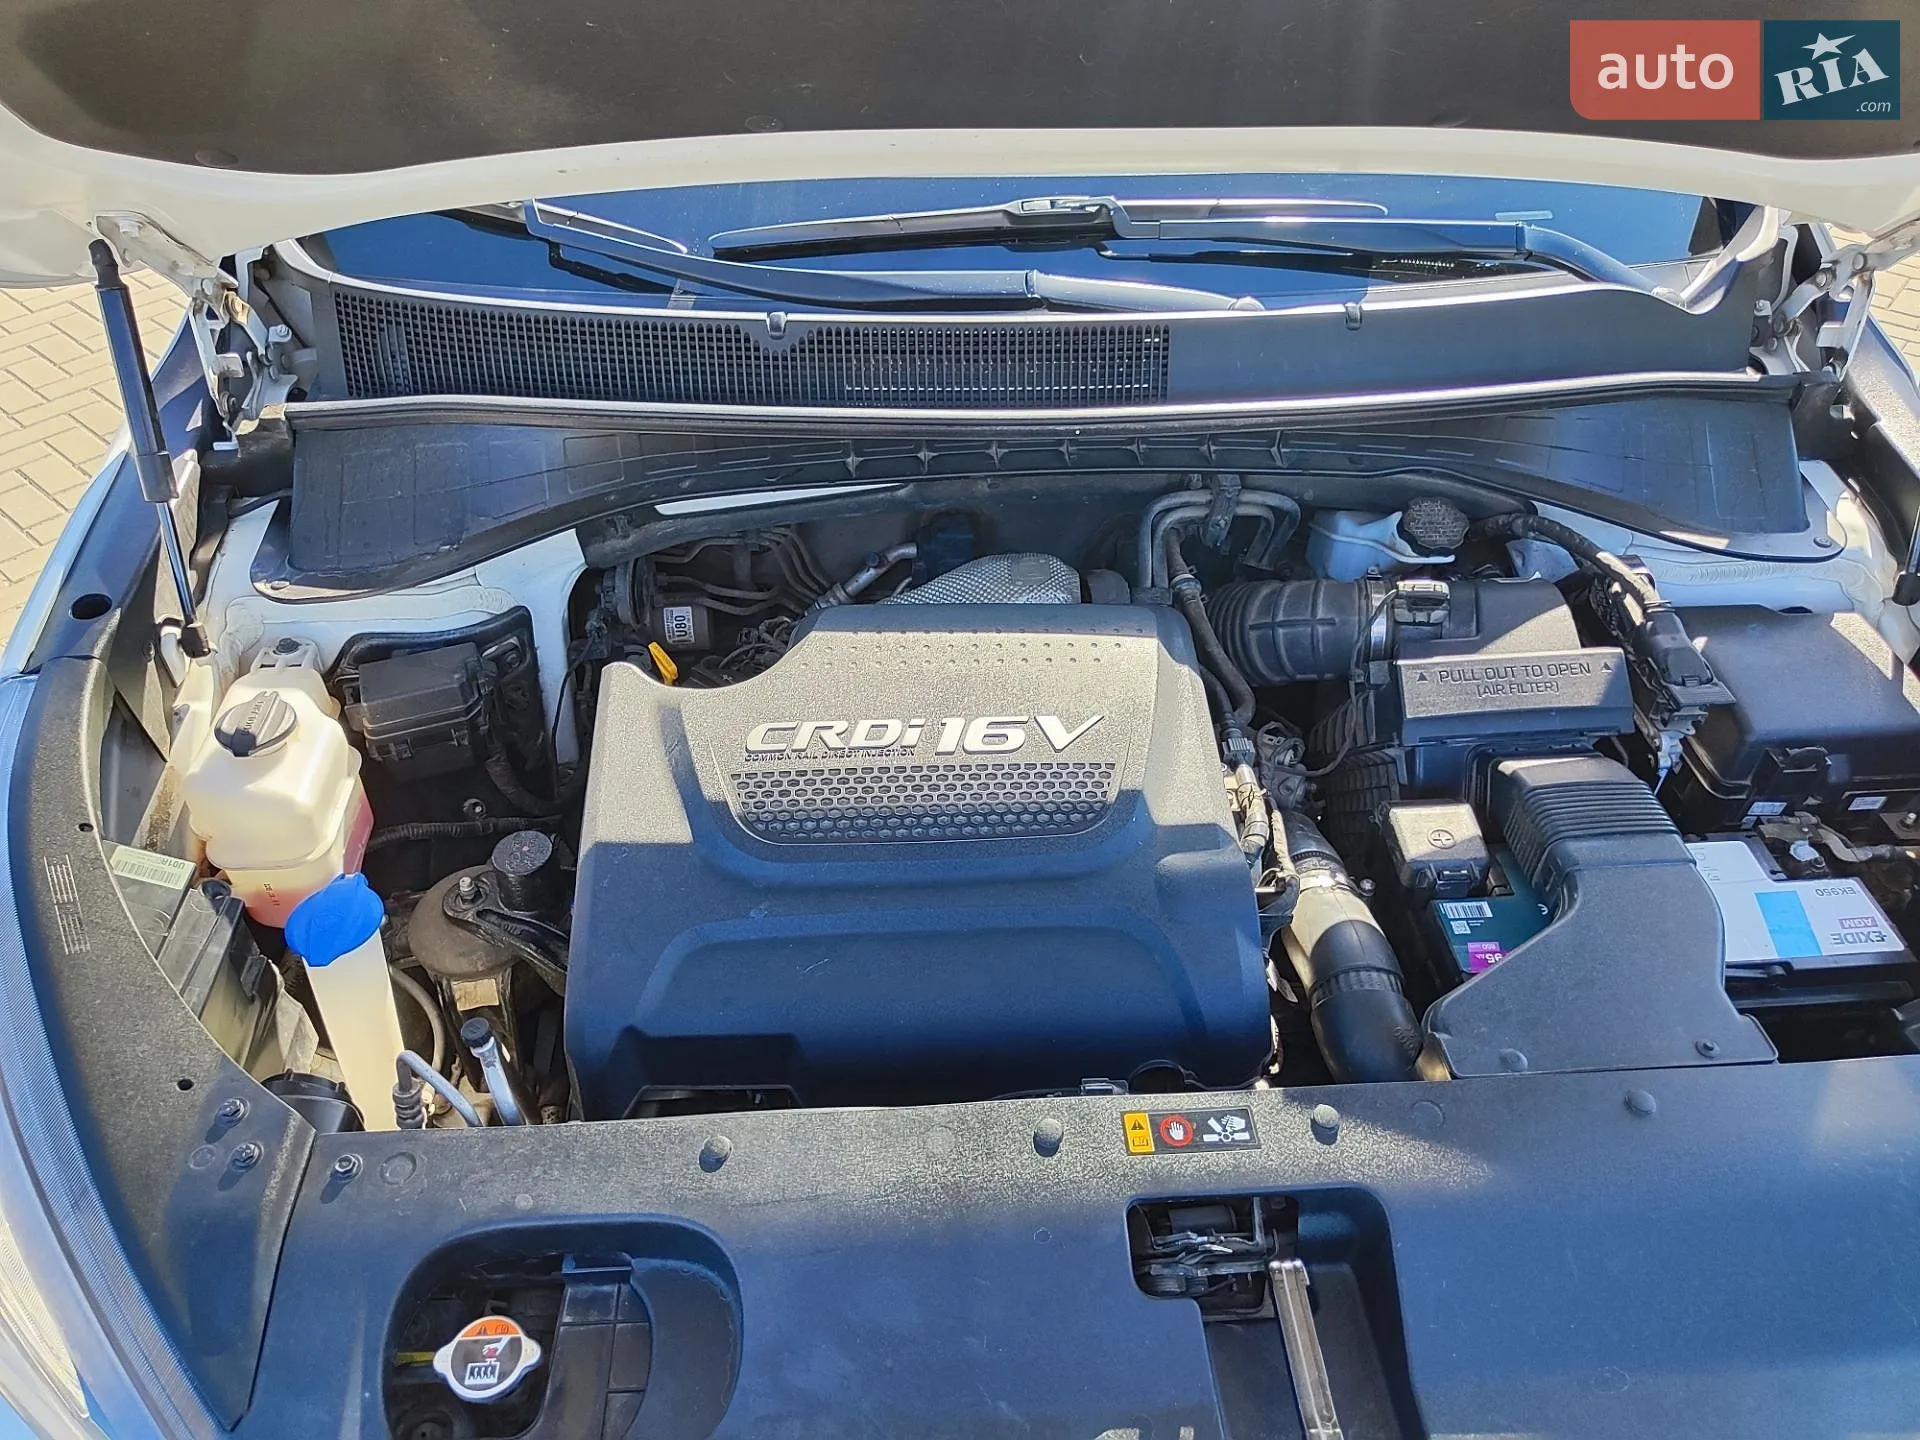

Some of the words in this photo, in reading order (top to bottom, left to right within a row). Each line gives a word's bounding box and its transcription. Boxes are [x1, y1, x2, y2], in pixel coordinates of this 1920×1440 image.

[673, 615, 686, 637] U80
[1438, 667, 1481, 683] PULL
[1484, 665, 1517, 681] OUT
[1521, 663, 1543, 679] TO
[1547, 661, 1591, 678] OPEN
[744, 752, 792, 763] COMMON
[794, 751, 818, 761] RAIL
[821, 750, 860, 760] DIRECT
[861, 748, 916, 759] INJECTION
[1815, 886, 1857, 897] EK950
[1842, 917, 1873, 928] AGM
[1830, 930, 1888, 945] EXIDE
